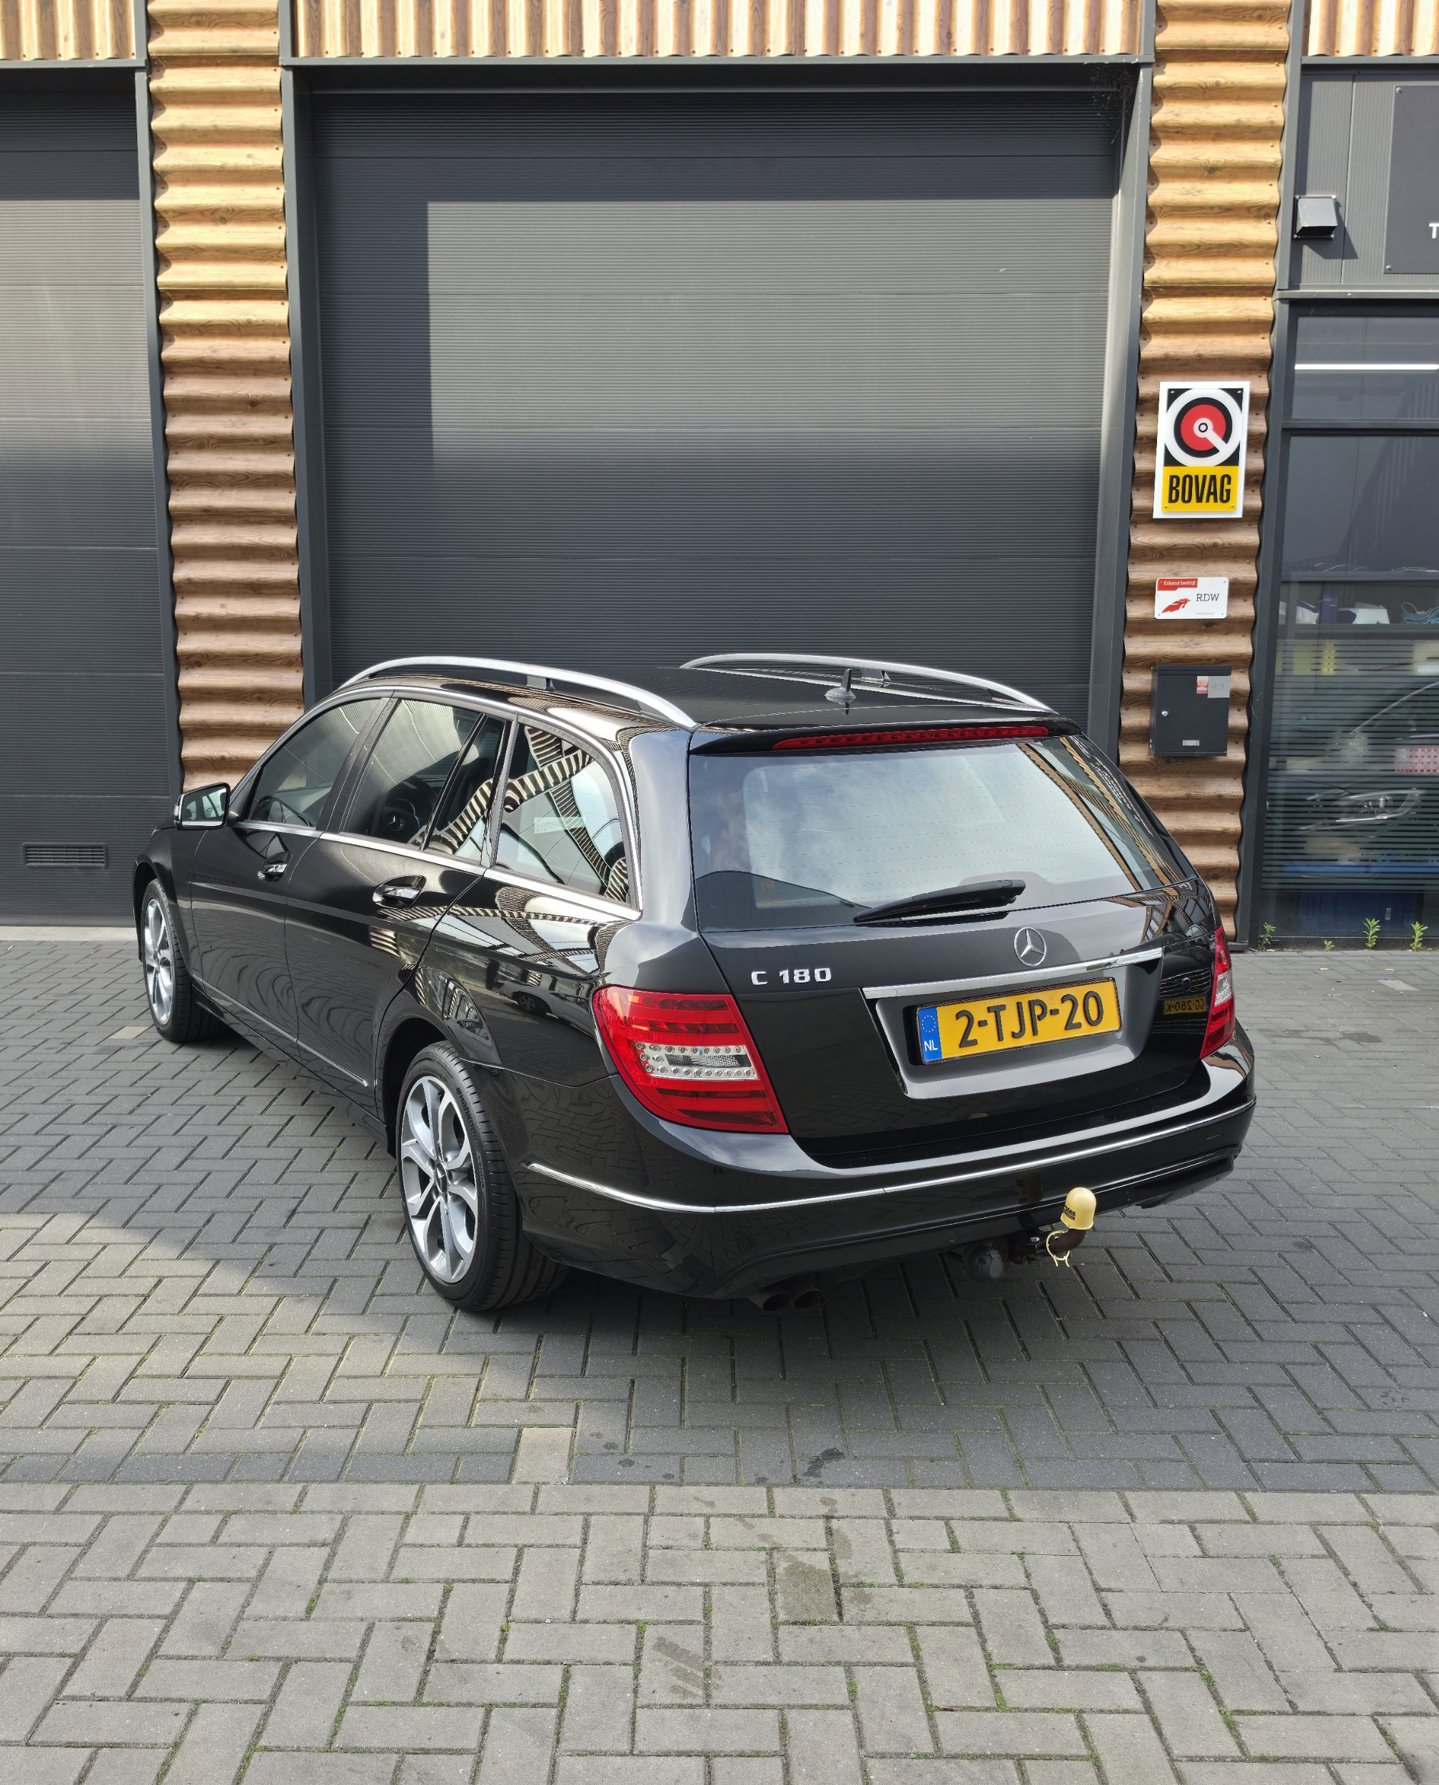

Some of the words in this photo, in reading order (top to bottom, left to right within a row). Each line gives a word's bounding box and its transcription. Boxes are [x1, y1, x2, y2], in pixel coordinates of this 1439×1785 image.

[1168, 474, 1231, 504] BOVAG
[1196, 593, 1220, 602] RDW
[751, 971, 768, 985] C
[779, 967, 832, 984] 180
[955, 990, 1104, 1048] 2-TJP-20
[924, 1038, 938, 1051] NL
